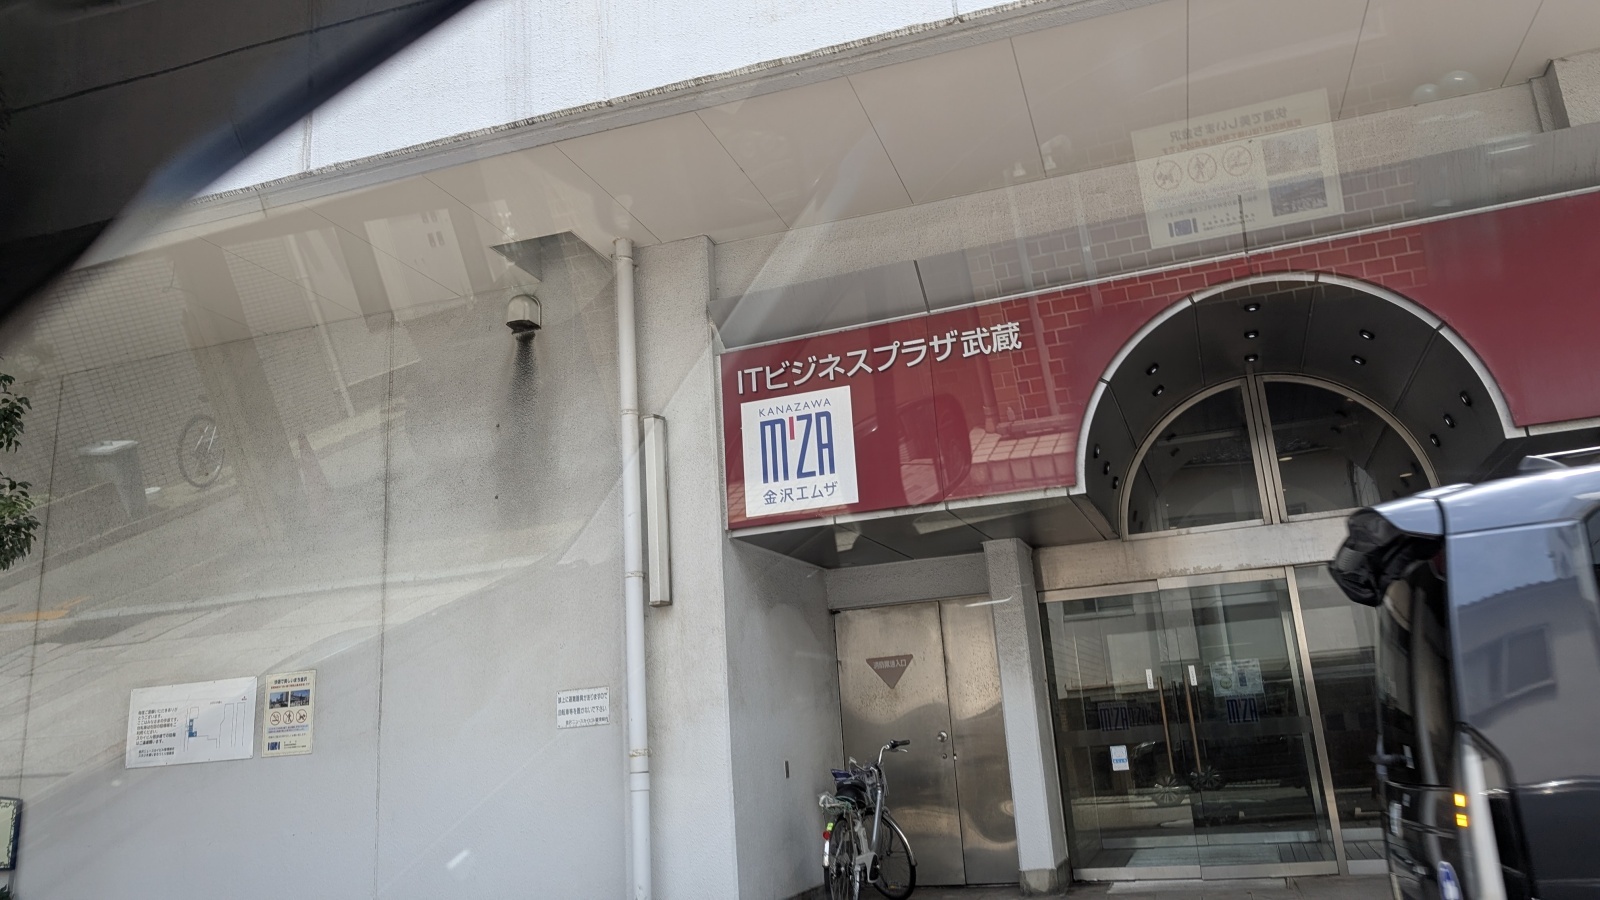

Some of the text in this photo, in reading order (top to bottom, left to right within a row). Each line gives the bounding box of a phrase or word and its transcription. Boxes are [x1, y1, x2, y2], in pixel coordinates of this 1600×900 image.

[737, 321, 1022, 394] ITビジネスプラザ武蔵
[758, 398, 831, 417] KANAZAWA
[763, 481, 838, 505] 金沢エムザ
